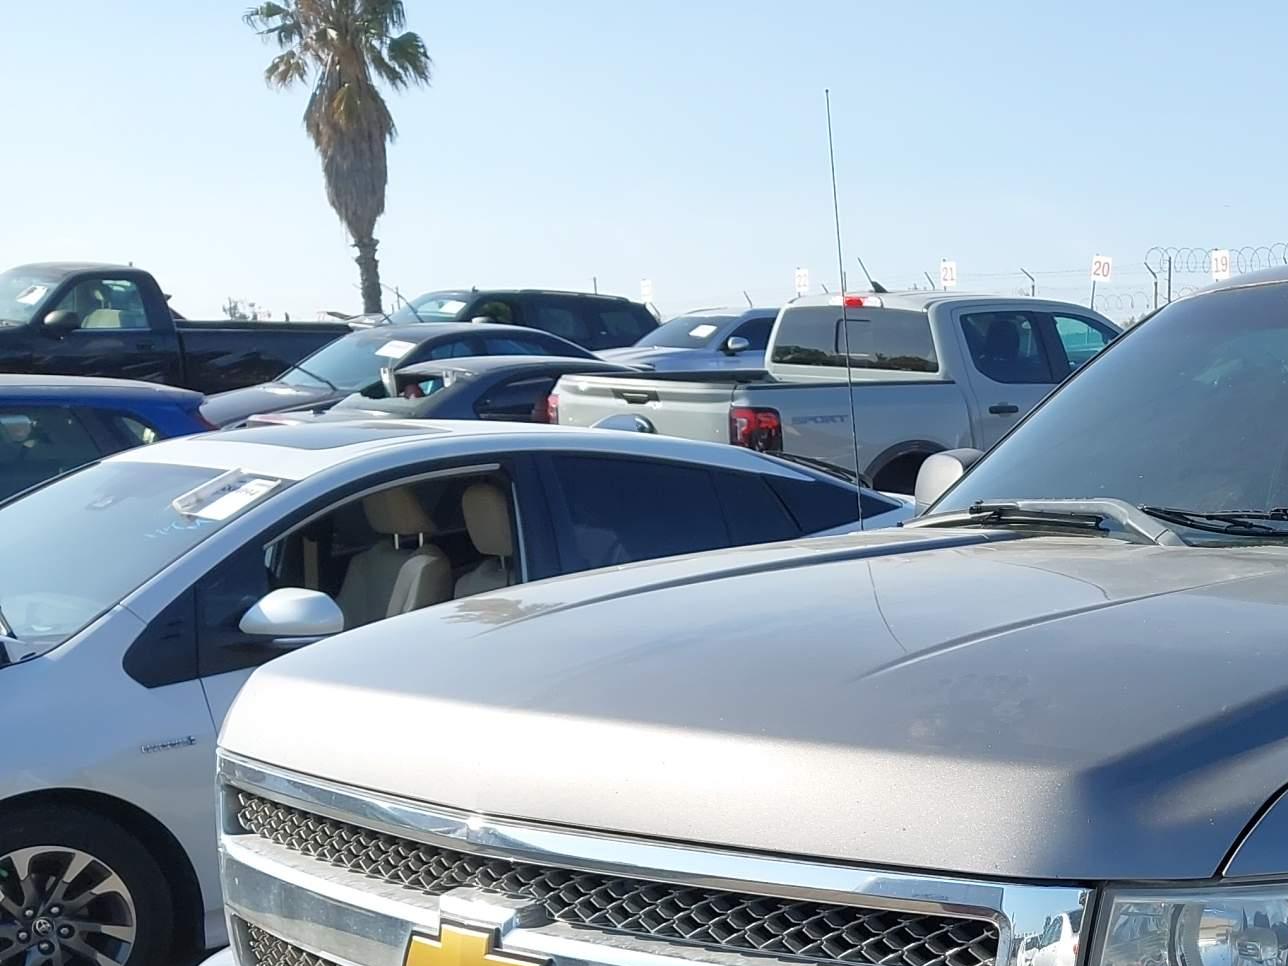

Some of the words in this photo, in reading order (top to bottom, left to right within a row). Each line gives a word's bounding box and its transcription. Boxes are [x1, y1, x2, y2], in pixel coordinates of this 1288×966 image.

[1093, 260, 1110, 278] 20
[1213, 256, 1228, 273] 19
[942, 266, 955, 282] 21
[791, 414, 849, 425] SPORT
